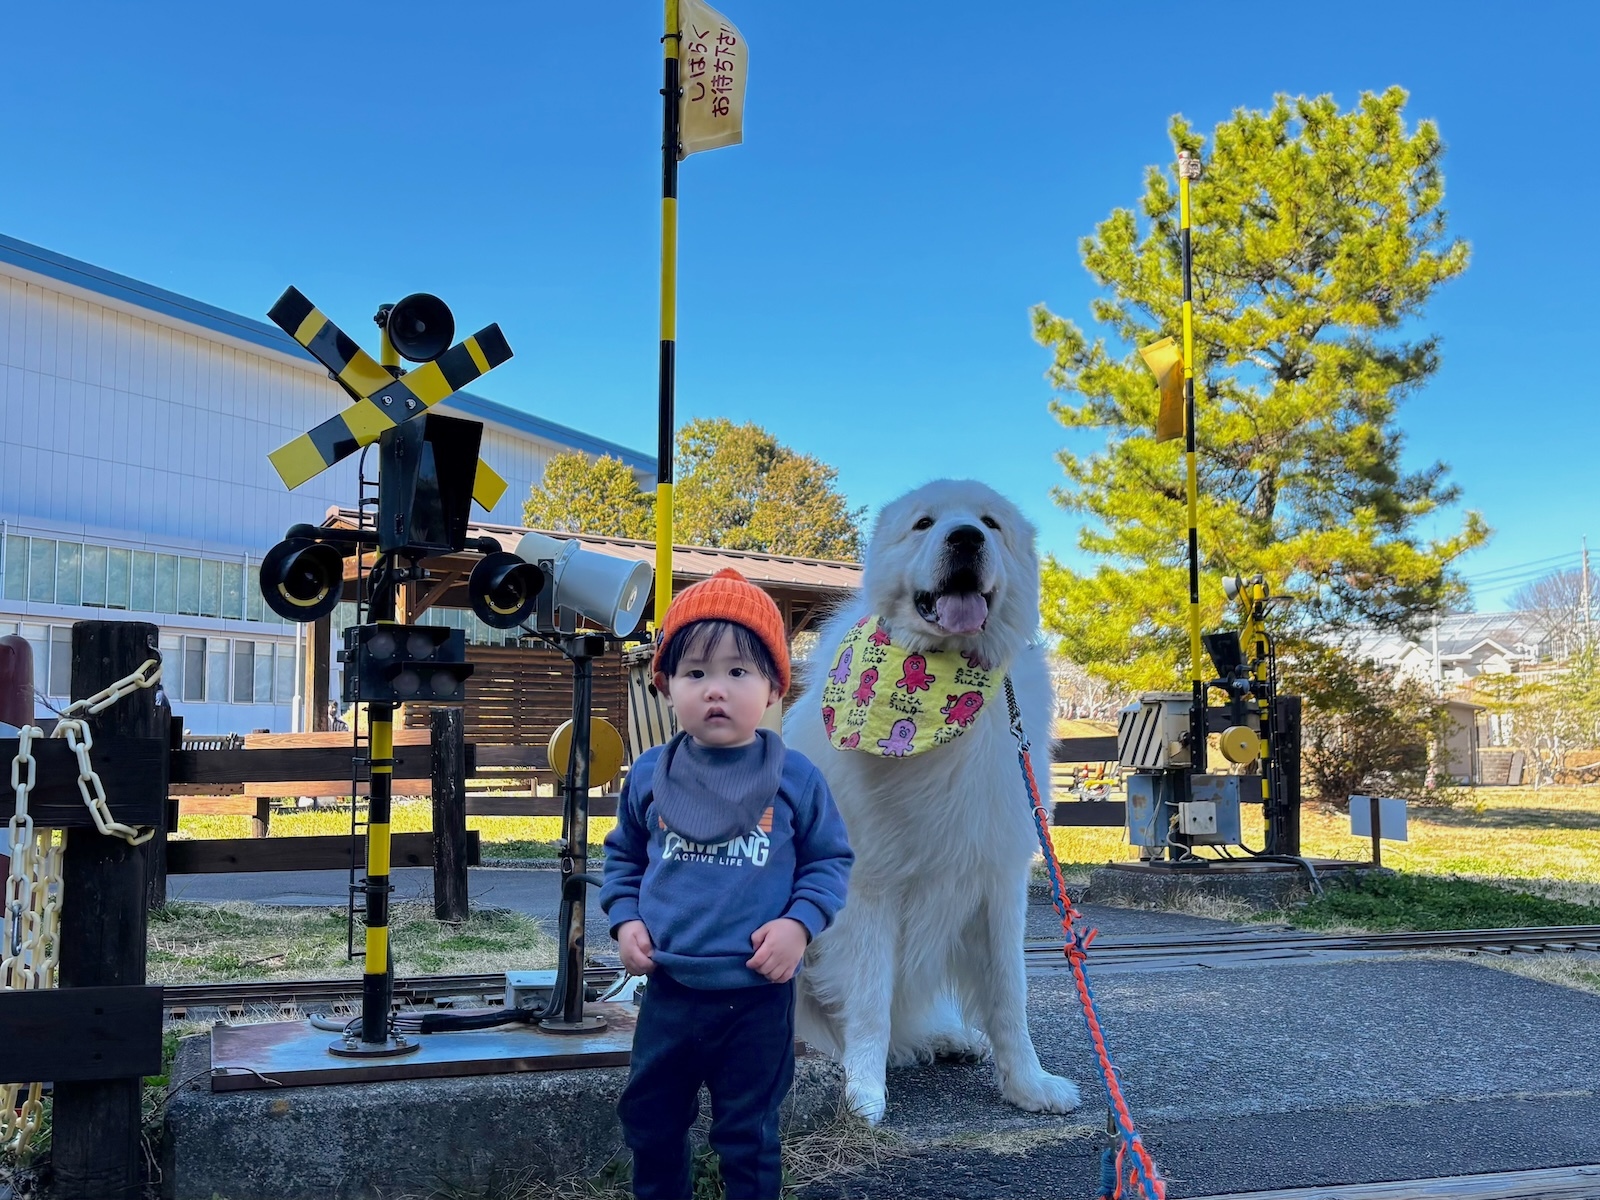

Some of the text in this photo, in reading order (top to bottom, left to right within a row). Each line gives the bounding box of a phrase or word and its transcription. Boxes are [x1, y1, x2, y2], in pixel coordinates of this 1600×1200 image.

[688, 24, 710, 101] しばらく
[674, 853, 743, 867] ACTIVE LIFE
